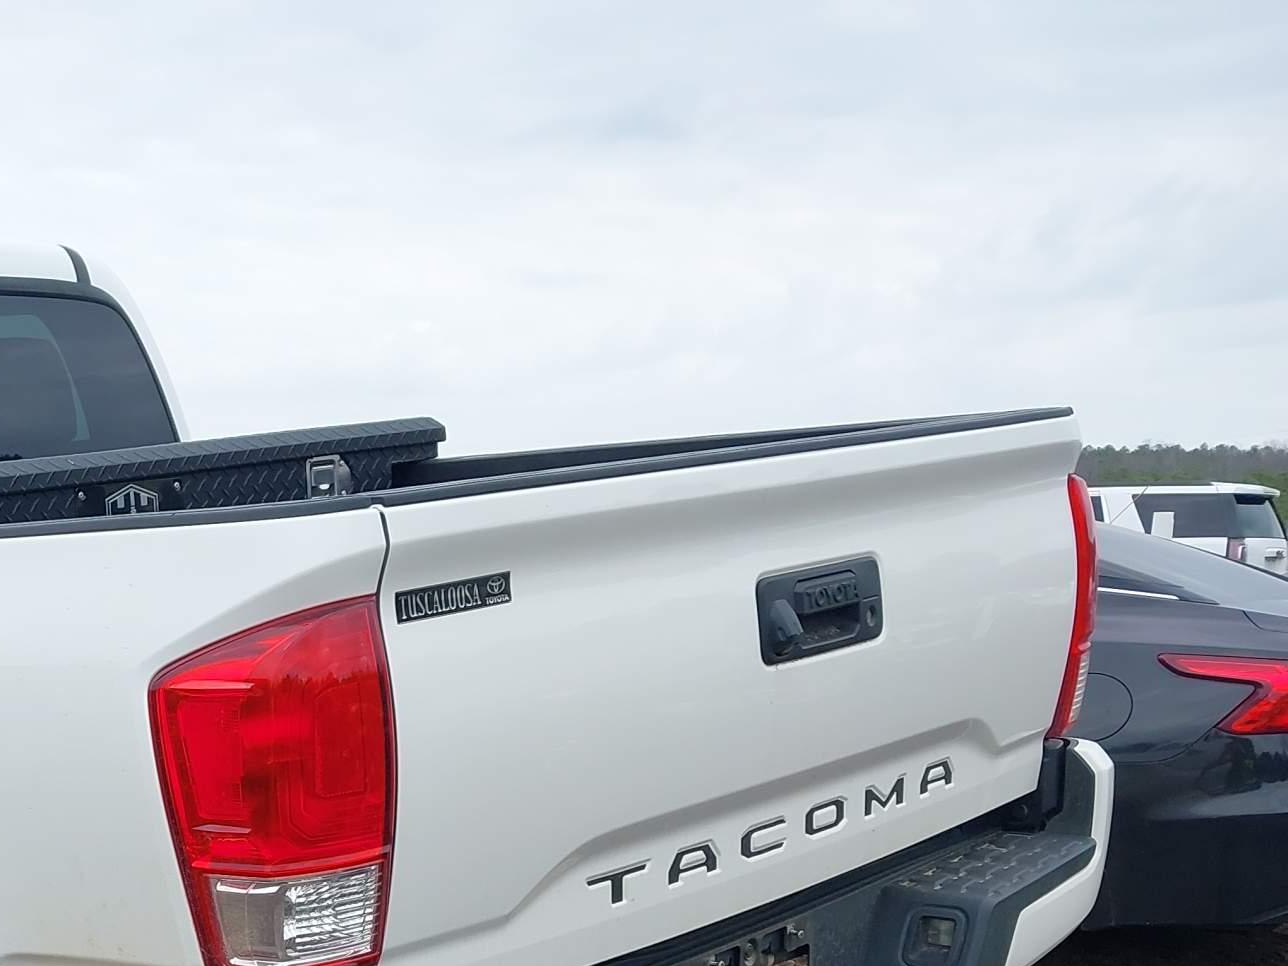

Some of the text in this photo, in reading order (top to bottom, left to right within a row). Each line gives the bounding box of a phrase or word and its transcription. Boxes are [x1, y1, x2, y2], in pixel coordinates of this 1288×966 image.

[398, 582, 482, 620] TUSCALOOSA
[485, 593, 510, 605] TOYOTA
[586, 758, 954, 905] TACOMA
